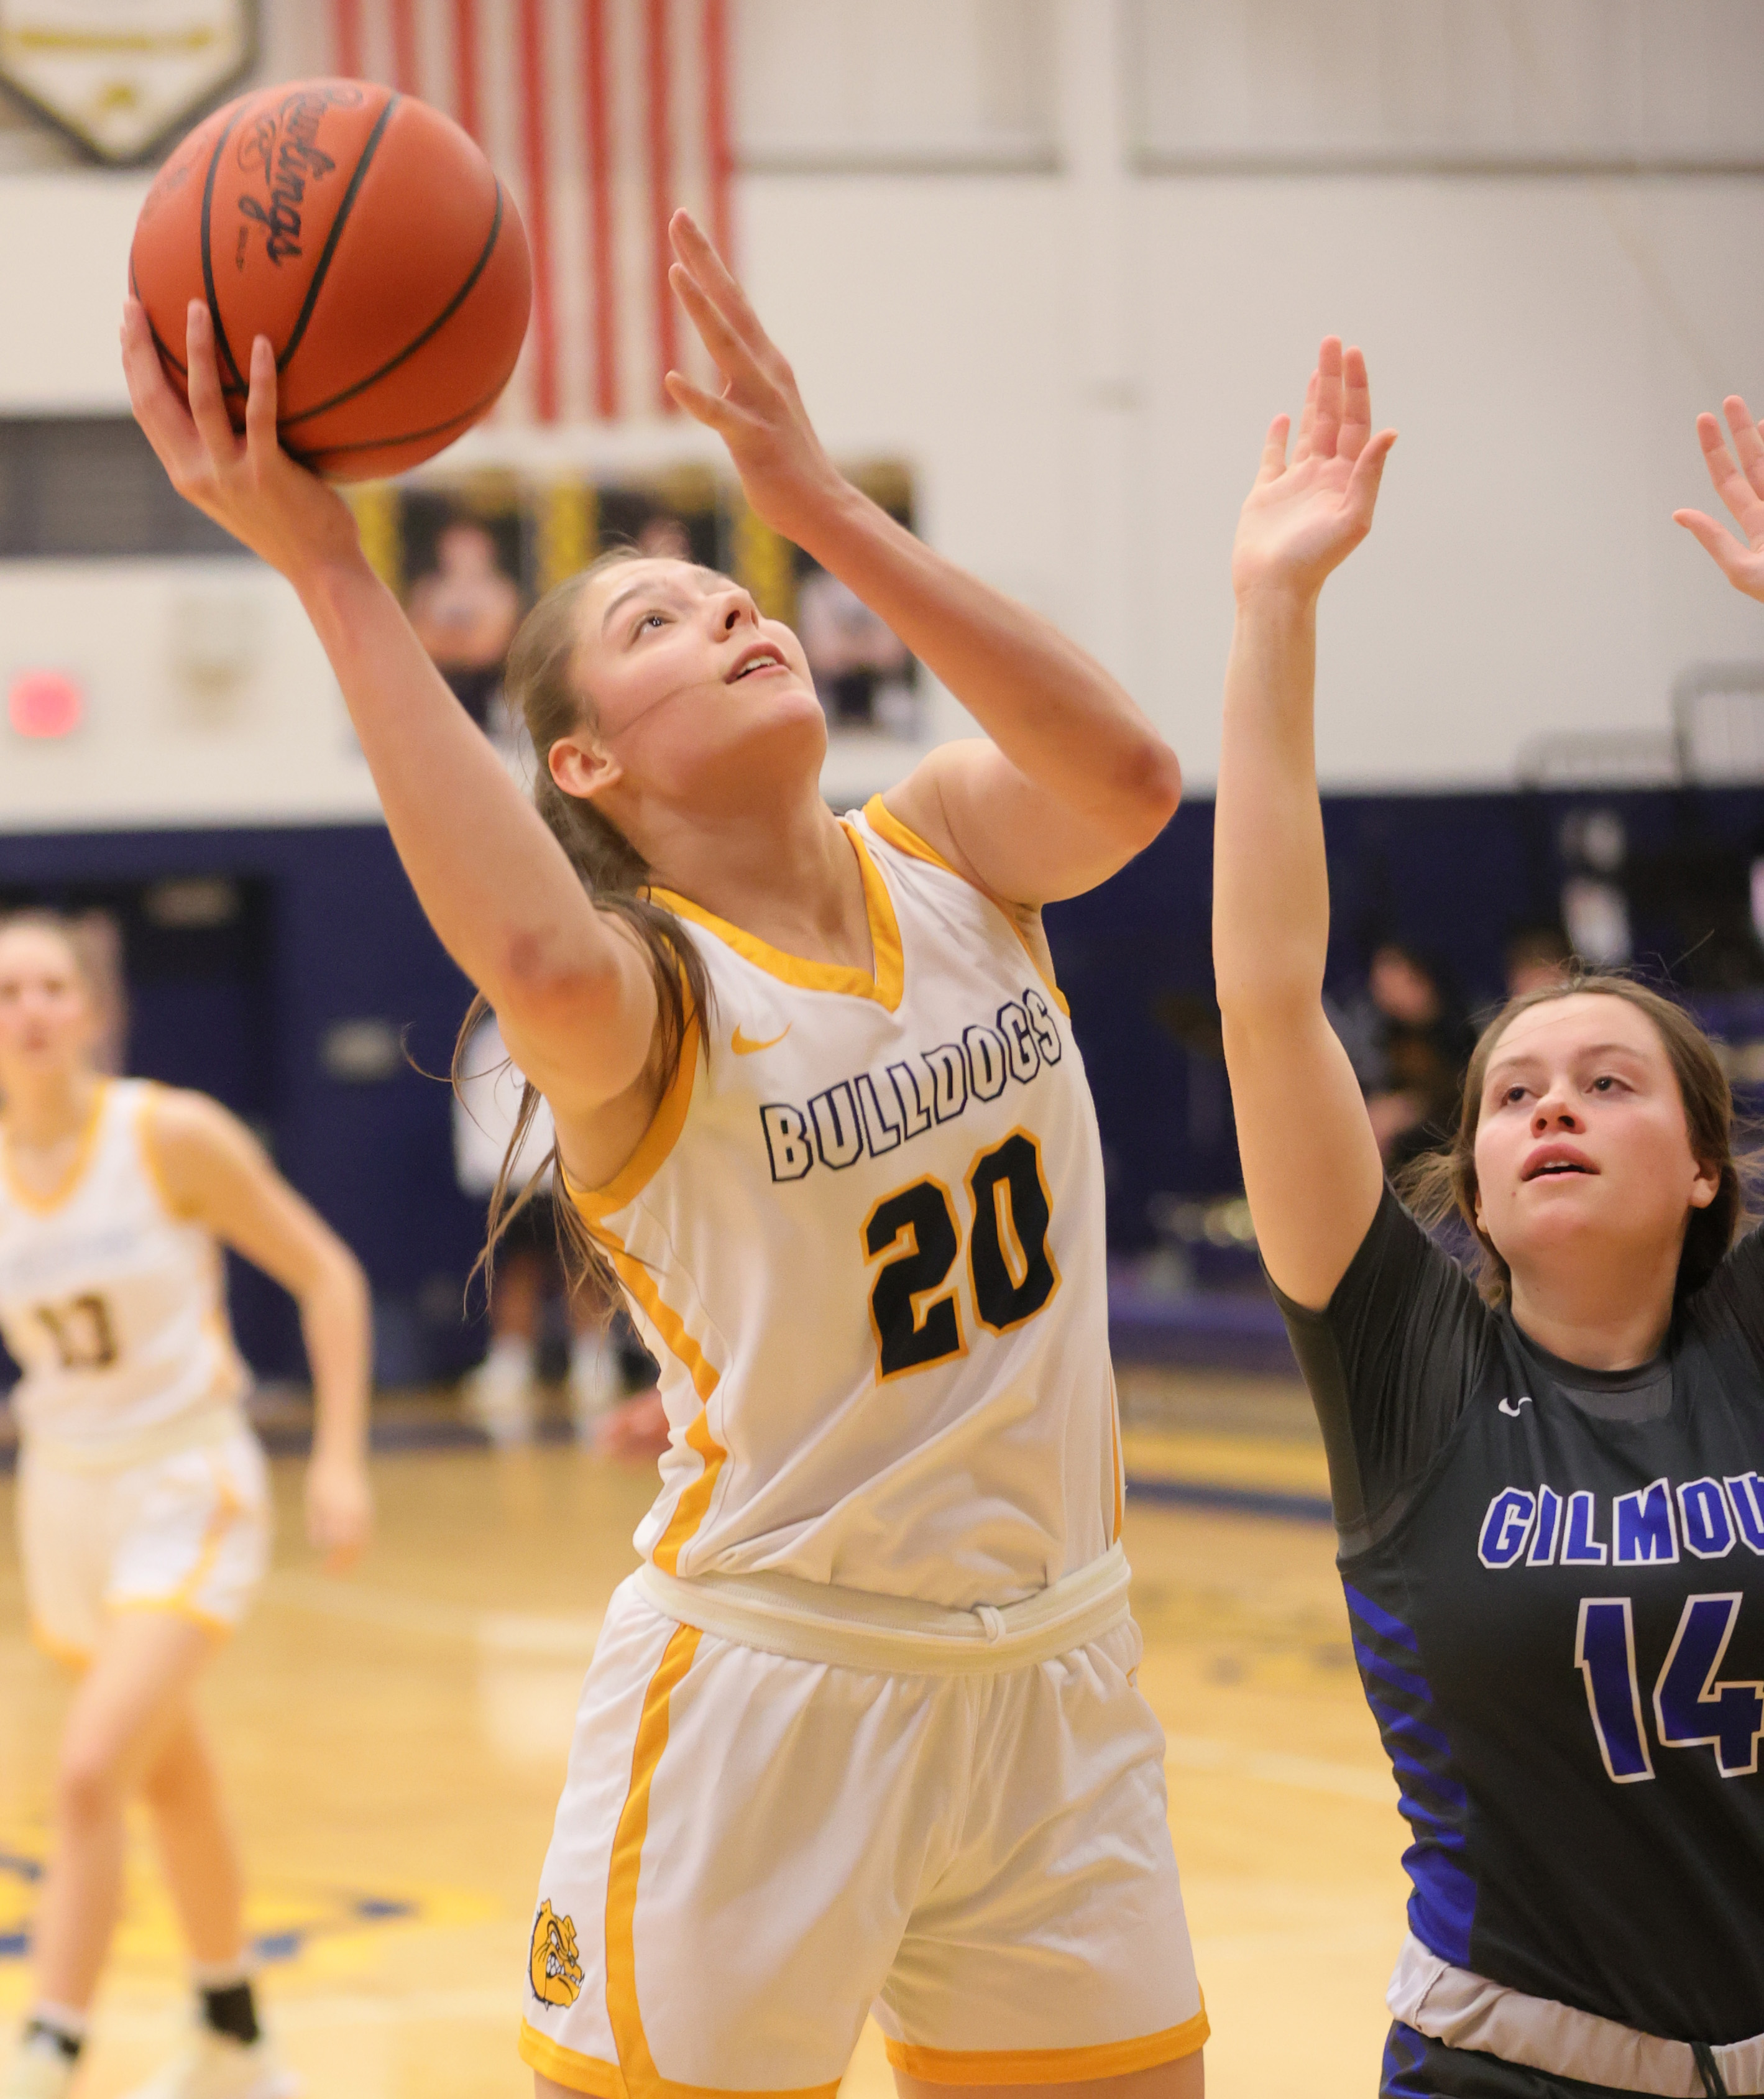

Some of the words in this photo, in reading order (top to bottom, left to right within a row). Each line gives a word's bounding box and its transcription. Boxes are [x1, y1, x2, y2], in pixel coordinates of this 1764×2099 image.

[760, 988, 1062, 1182] BULLDOGS
[859, 1124, 1062, 1386] 20
[1574, 1592, 1764, 1784] 14
